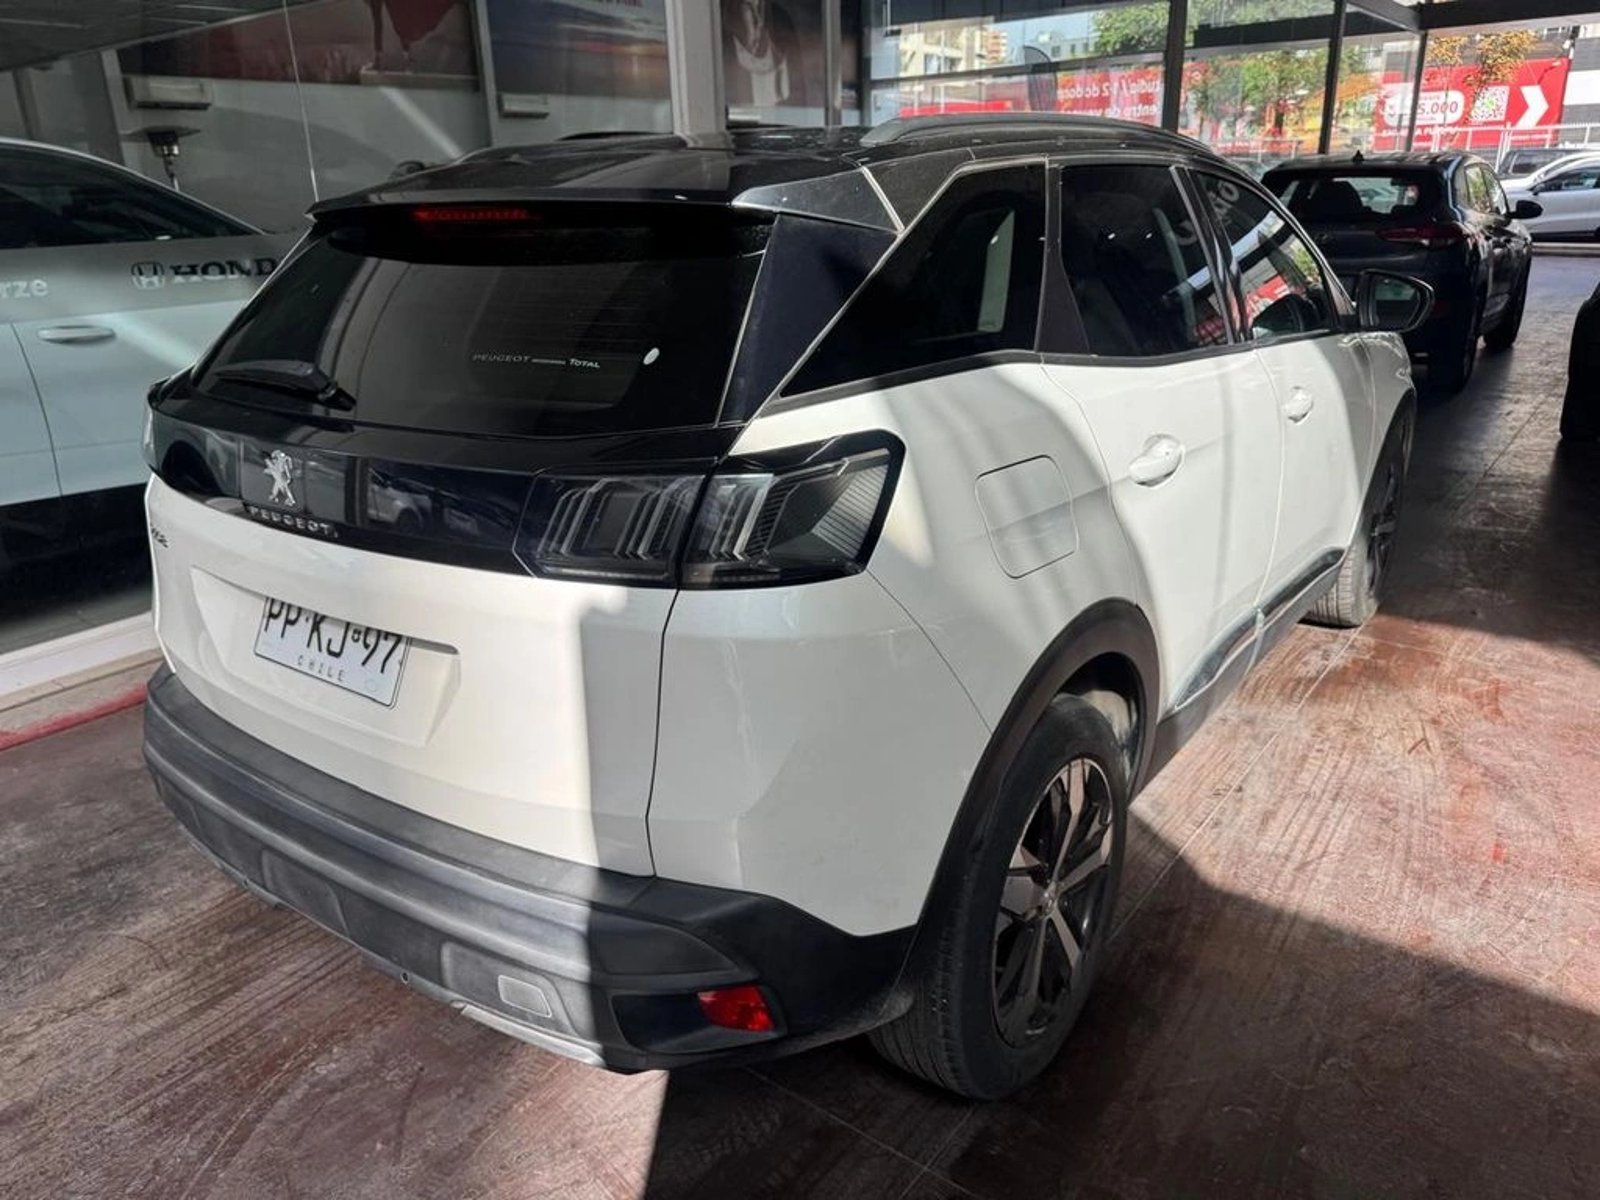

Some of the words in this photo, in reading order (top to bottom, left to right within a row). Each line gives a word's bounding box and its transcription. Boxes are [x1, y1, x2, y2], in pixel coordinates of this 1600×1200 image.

[169, 258, 277, 283] HOND
[472, 353, 531, 363] PEUGEOT
[569, 357, 601, 369] TOTAL
[247, 506, 329, 536] PEUGEOT
[297, 655, 345, 682] CHILE
